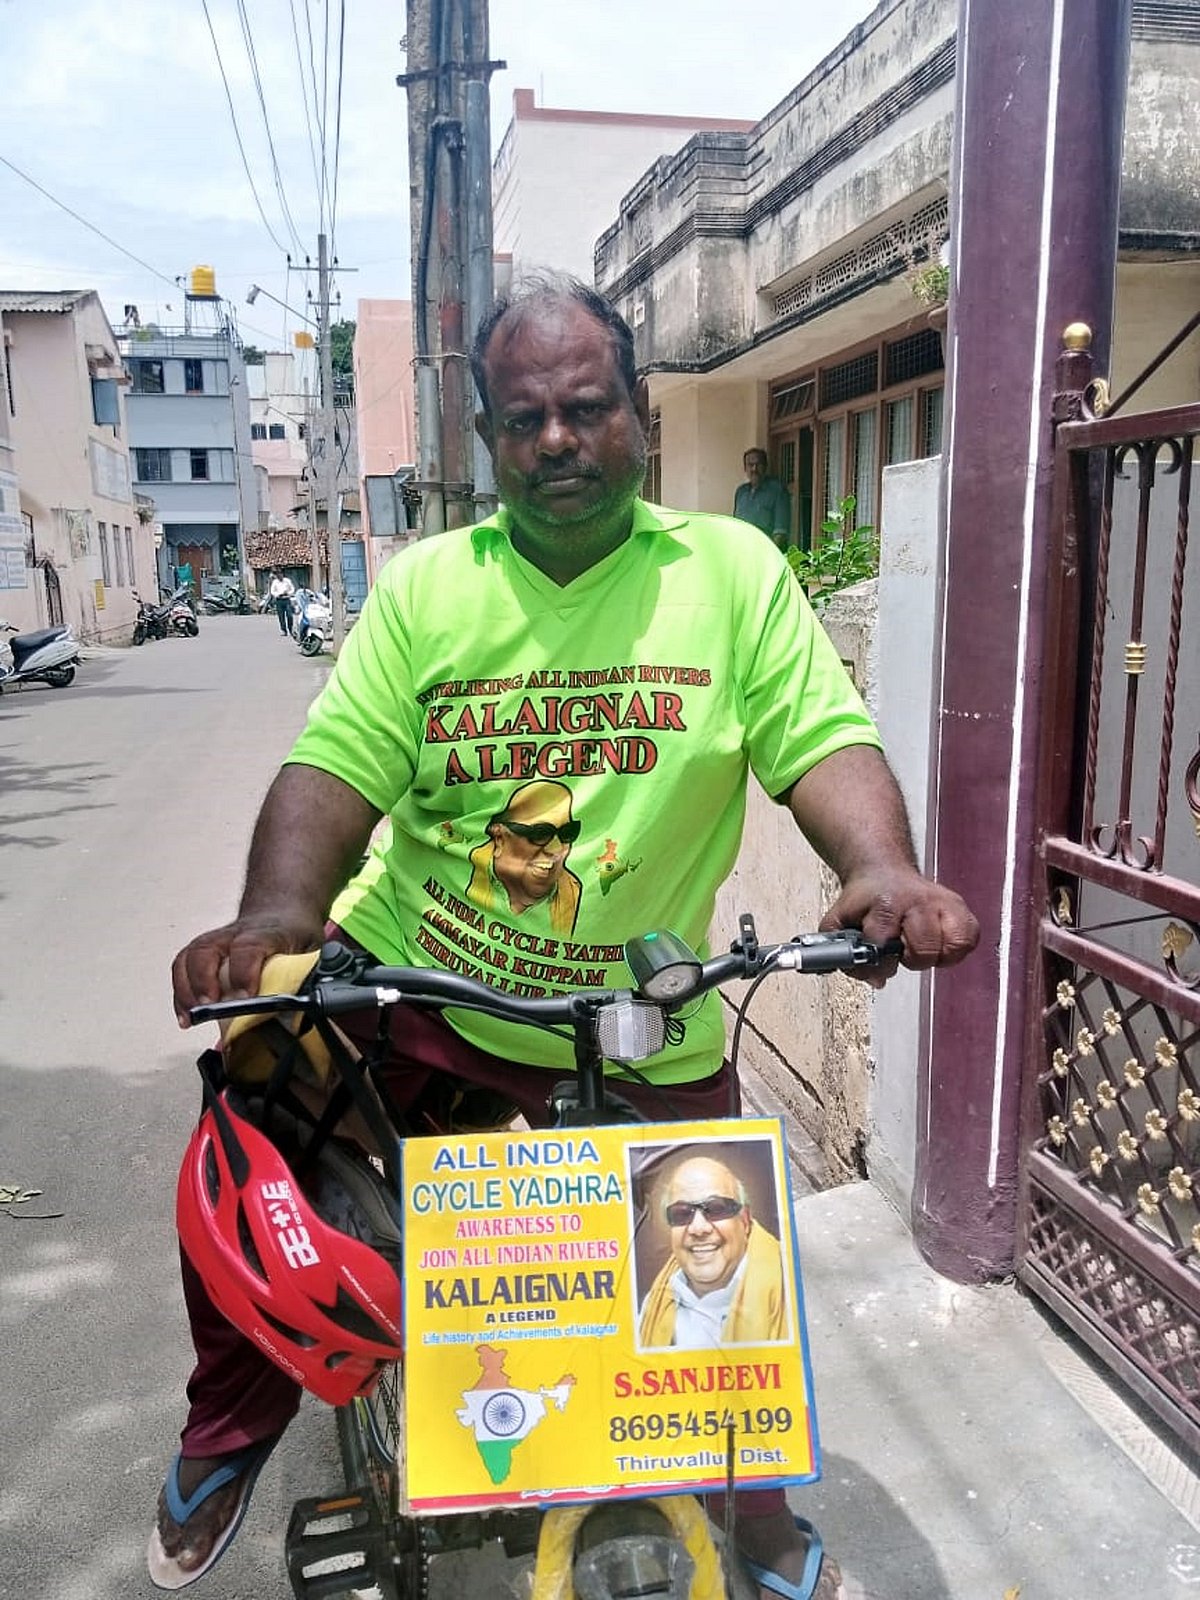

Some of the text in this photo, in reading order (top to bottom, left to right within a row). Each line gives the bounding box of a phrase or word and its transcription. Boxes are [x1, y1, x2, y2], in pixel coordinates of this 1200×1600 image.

[525, 670, 567, 689] ALL
[569, 667, 636, 689] INDIAN
[638, 665, 711, 687] RIVERS
[425, 690, 687, 743] KALAIGNAR
[445, 736, 658, 786] A LEGEND
[422, 876, 446, 906] ALL
[444, 893, 486, 934] INDIA
[487, 921, 558, 957] CYCLE
[422, 909, 607, 986] AMMAYAR KUPPAM
[433, 1140, 600, 1171] ALL INDIA
[412, 1173, 623, 1213] CYCLE YADHRA
[456, 1214, 582, 1238] AWARENESS TO
[419, 1240, 619, 1269] JOIN ALL INDIAN RIVERS
[424, 1270, 616, 1309] KALAIGNAR
[423, 1323, 618, 1345] Life history and Achievements of kalaignar
[485, 1309, 557, 1324] A LEGEND
[614, 1362, 782, 1399] S.SANJEEVI
[609, 1406, 793, 1443] 8695454199
[615, 1448, 788, 1472] Thiruvallu Dist.
